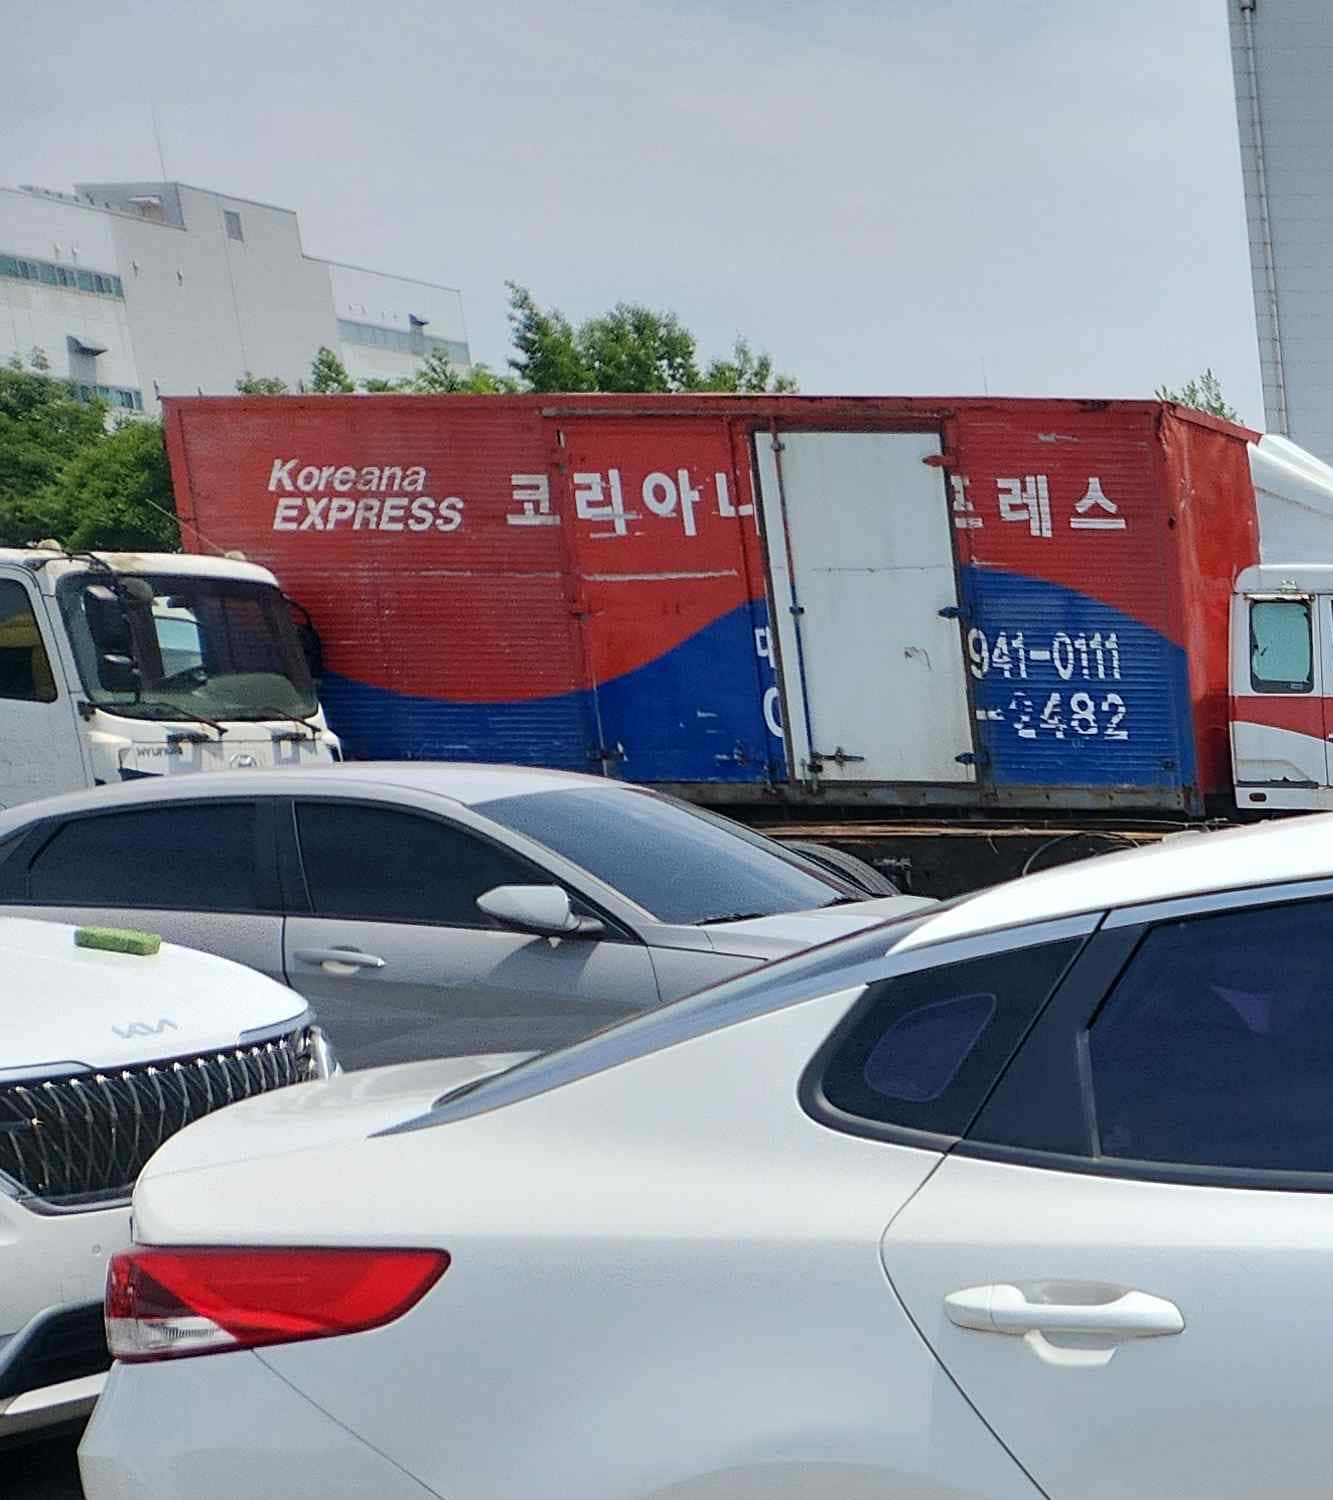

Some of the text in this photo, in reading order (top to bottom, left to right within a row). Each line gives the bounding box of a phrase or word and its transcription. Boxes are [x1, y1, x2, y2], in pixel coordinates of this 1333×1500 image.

[267, 459, 427, 492] Koreana
[272, 497, 464, 531] EXPRESS
[968, 628, 1120, 680] 941-0111
